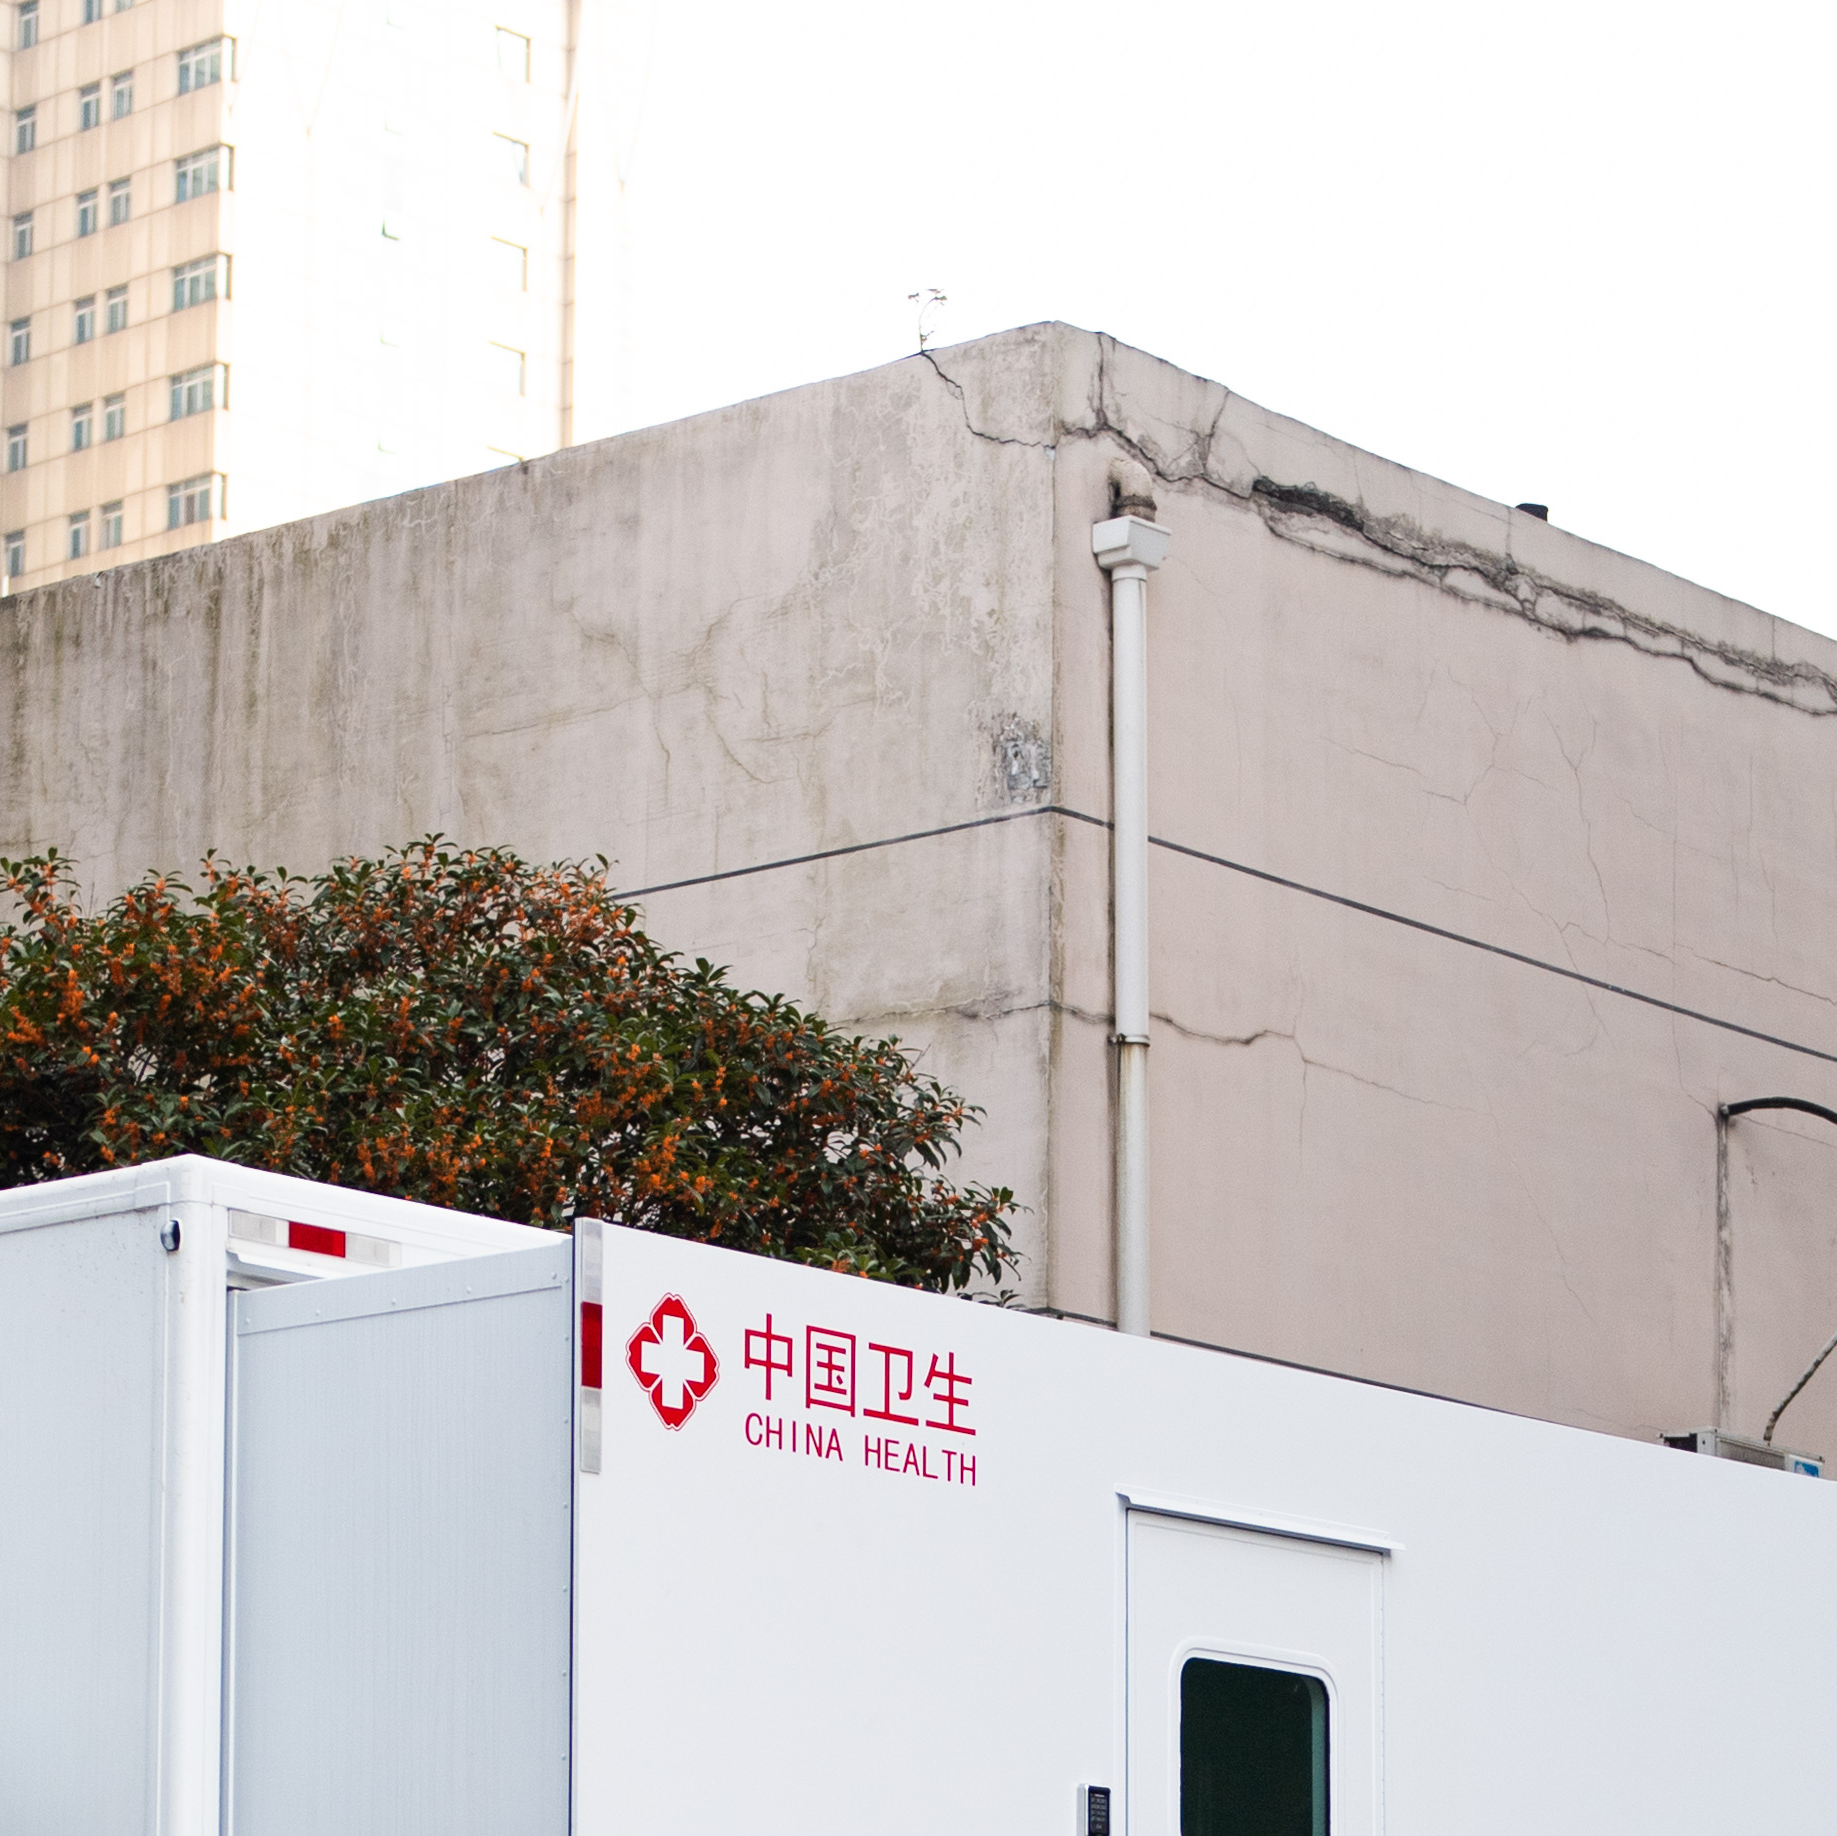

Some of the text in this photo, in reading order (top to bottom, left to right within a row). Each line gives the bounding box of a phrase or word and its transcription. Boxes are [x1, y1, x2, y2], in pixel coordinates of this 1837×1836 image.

[744, 1313, 976, 1436] 中国卫生
[744, 1412, 976, 1486] CHINA HEALTH
